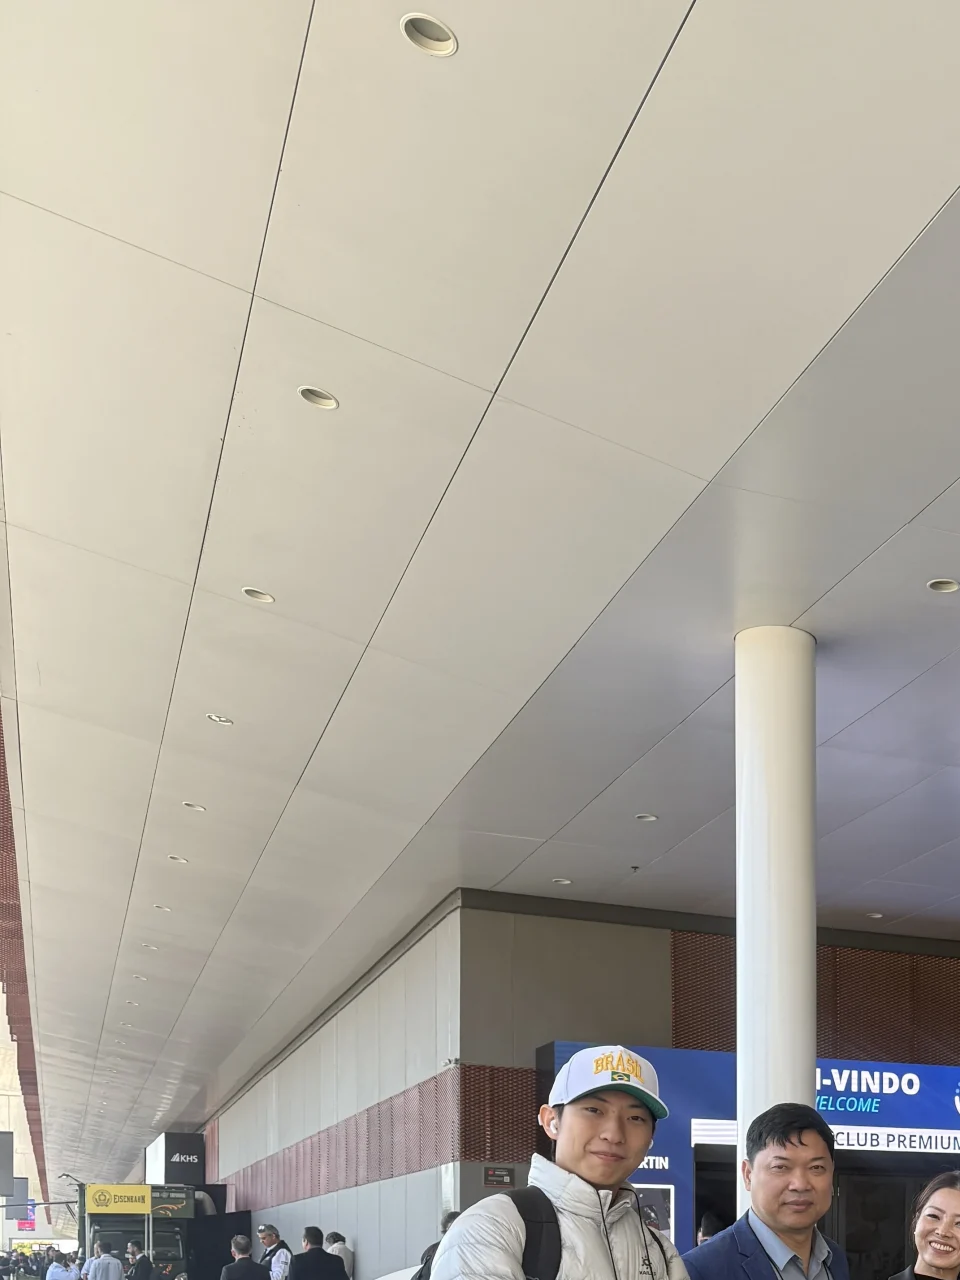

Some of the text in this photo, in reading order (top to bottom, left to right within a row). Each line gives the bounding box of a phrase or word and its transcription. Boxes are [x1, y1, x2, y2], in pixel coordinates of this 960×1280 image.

[593, 1051, 644, 1084] BRASIL
[816, 1095, 880, 1113] ELCOME
[835, 1131, 880, 1148] CLUB
[180, 1154, 198, 1163] KHS
[113, 1194, 146, 1204] EISENBAHN
